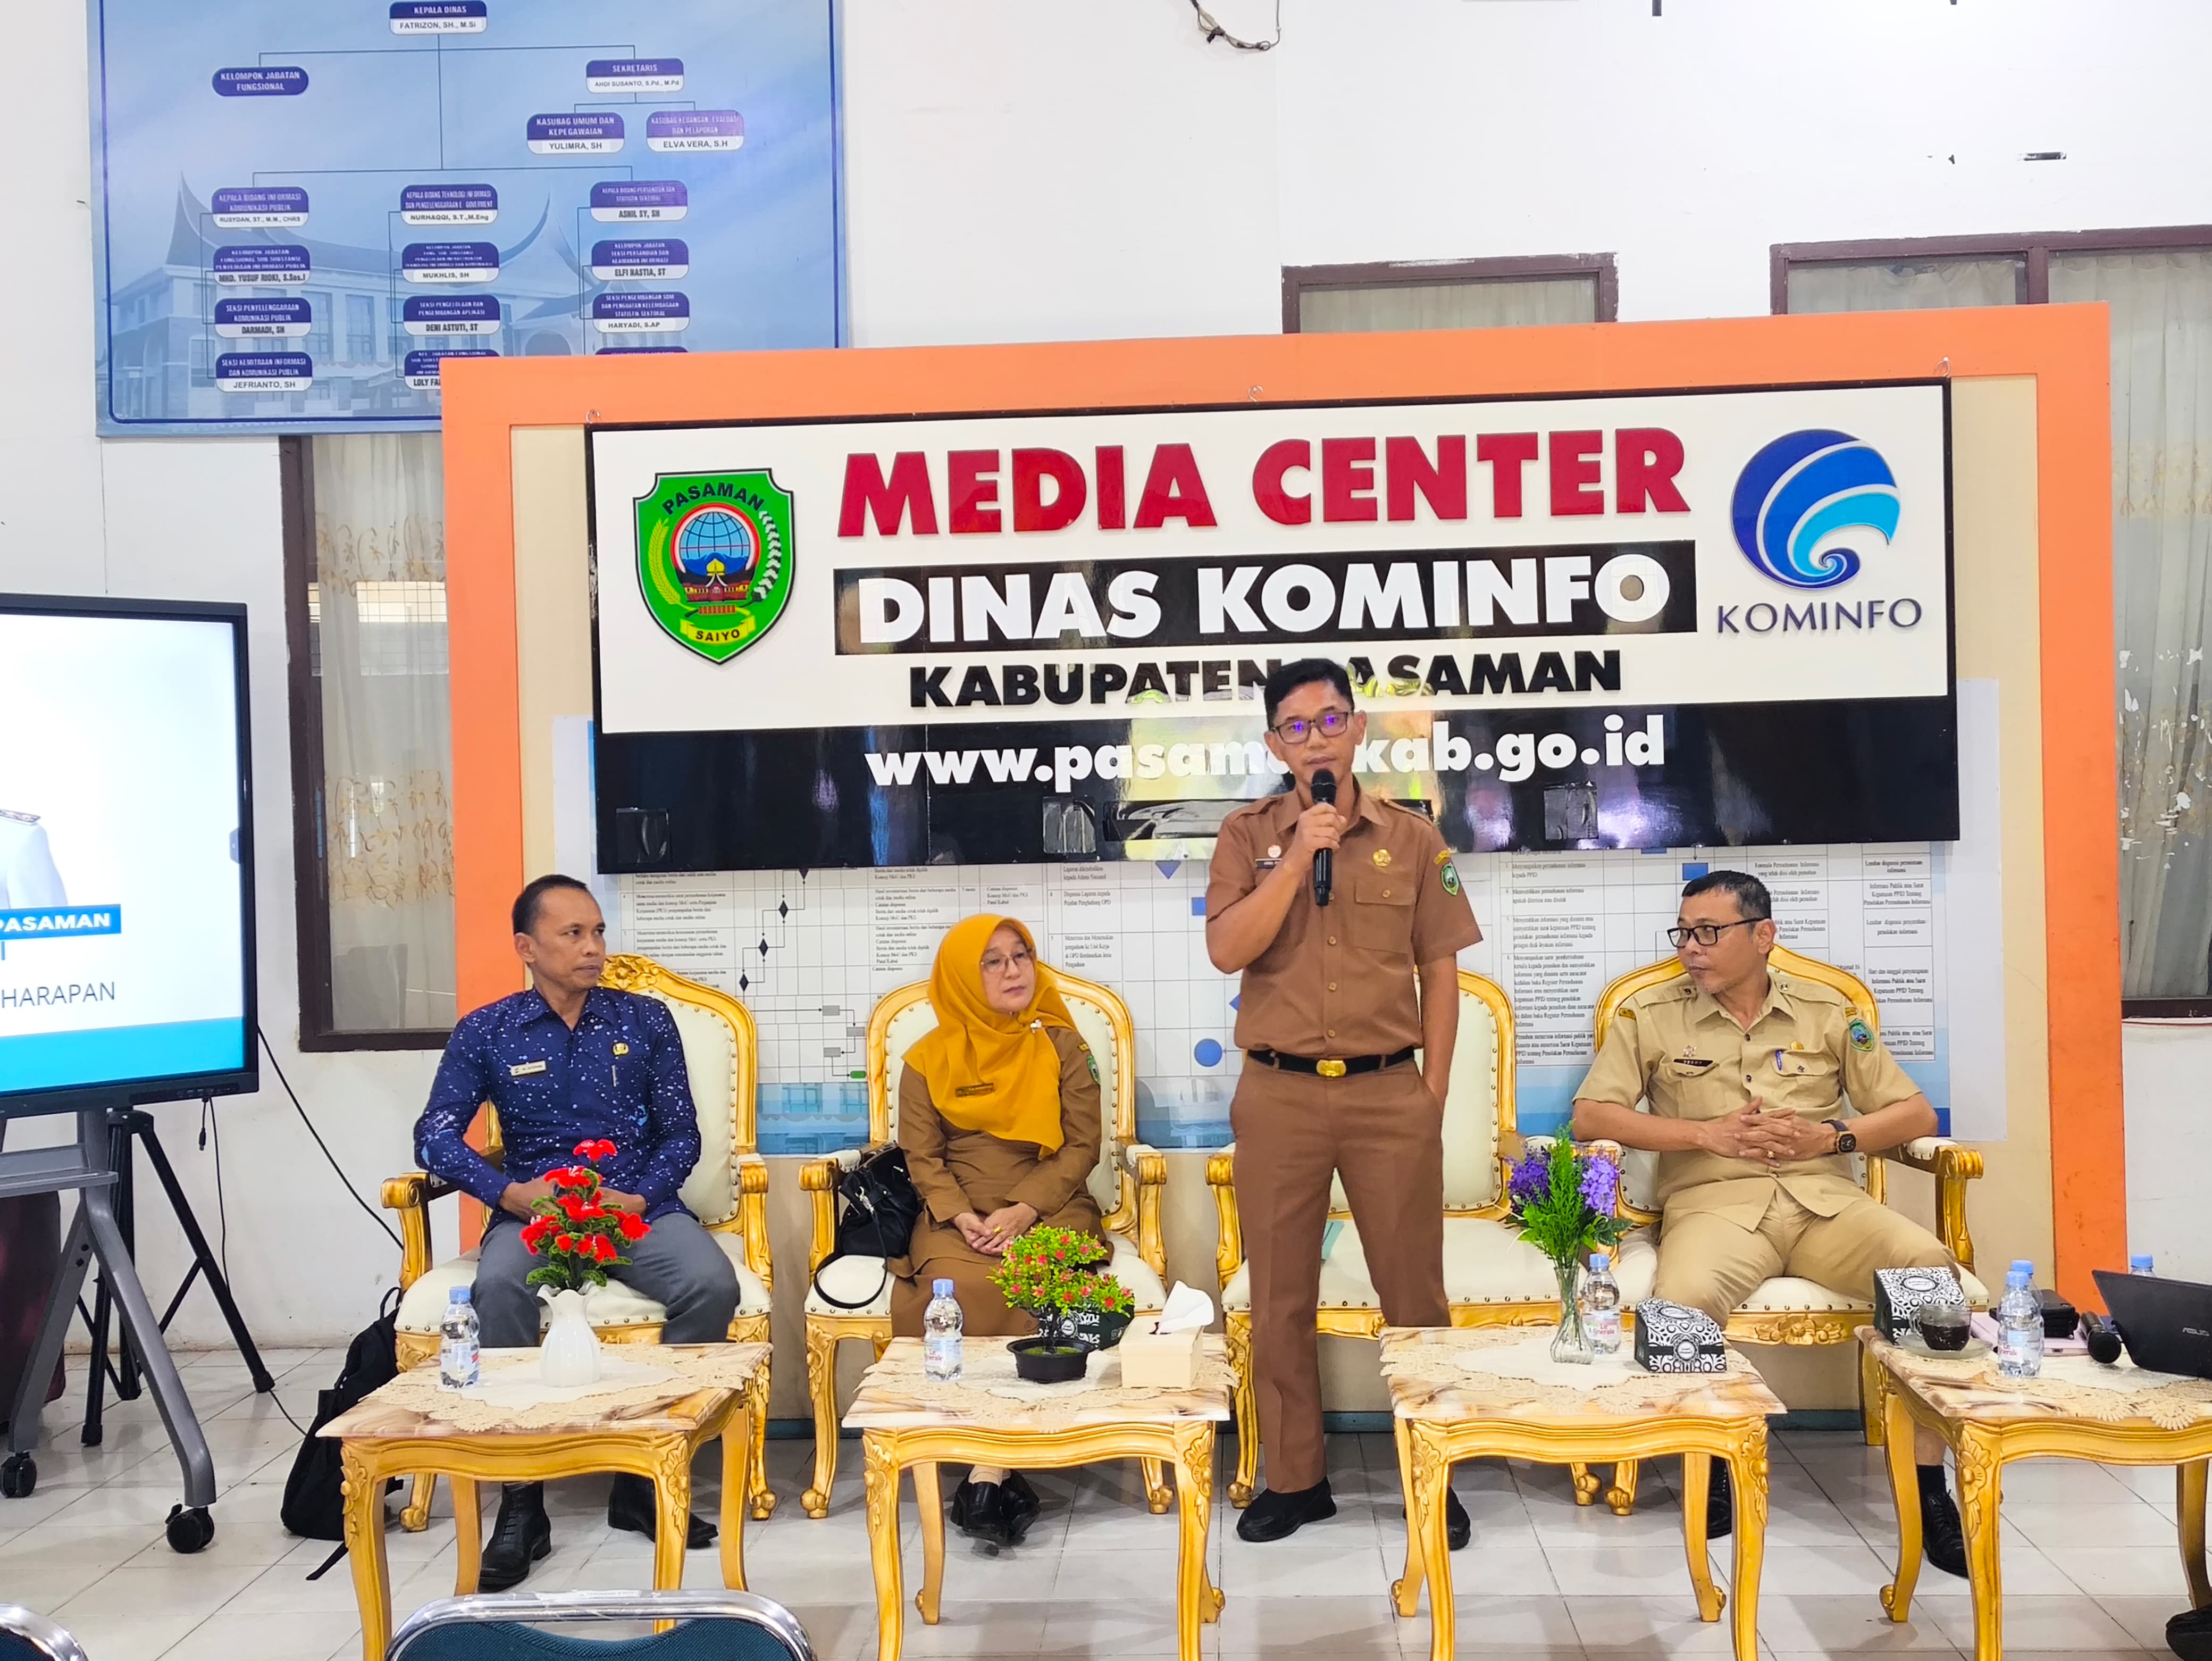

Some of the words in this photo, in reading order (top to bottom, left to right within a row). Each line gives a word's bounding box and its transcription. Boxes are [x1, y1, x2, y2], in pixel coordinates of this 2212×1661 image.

[221, 72, 263, 80] KELOMPOK
[237, 82, 284, 91] FUNGSIONAL
[242, 326, 274, 335] DARMADI,
[443, 323, 468, 332] ASTUTI,
[837, 443, 1218, 537] MEDIA
[1252, 427, 1691, 525] CENTER
[662, 482, 765, 514] PASAMAN
[858, 567, 1162, 644] DINAS
[1198, 553, 1670, 635] KOMINFO
[1716, 598, 1923, 635] KOMINFO
[696, 629, 740, 641] SAIYO
[910, 658, 1282, 707] KABUPATEN
[1346, 649, 1621, 698] ASAMAN
[865, 714, 1665, 792] www.pasamkab.go.id
[2, 981, 114, 1008] HARAPAN
